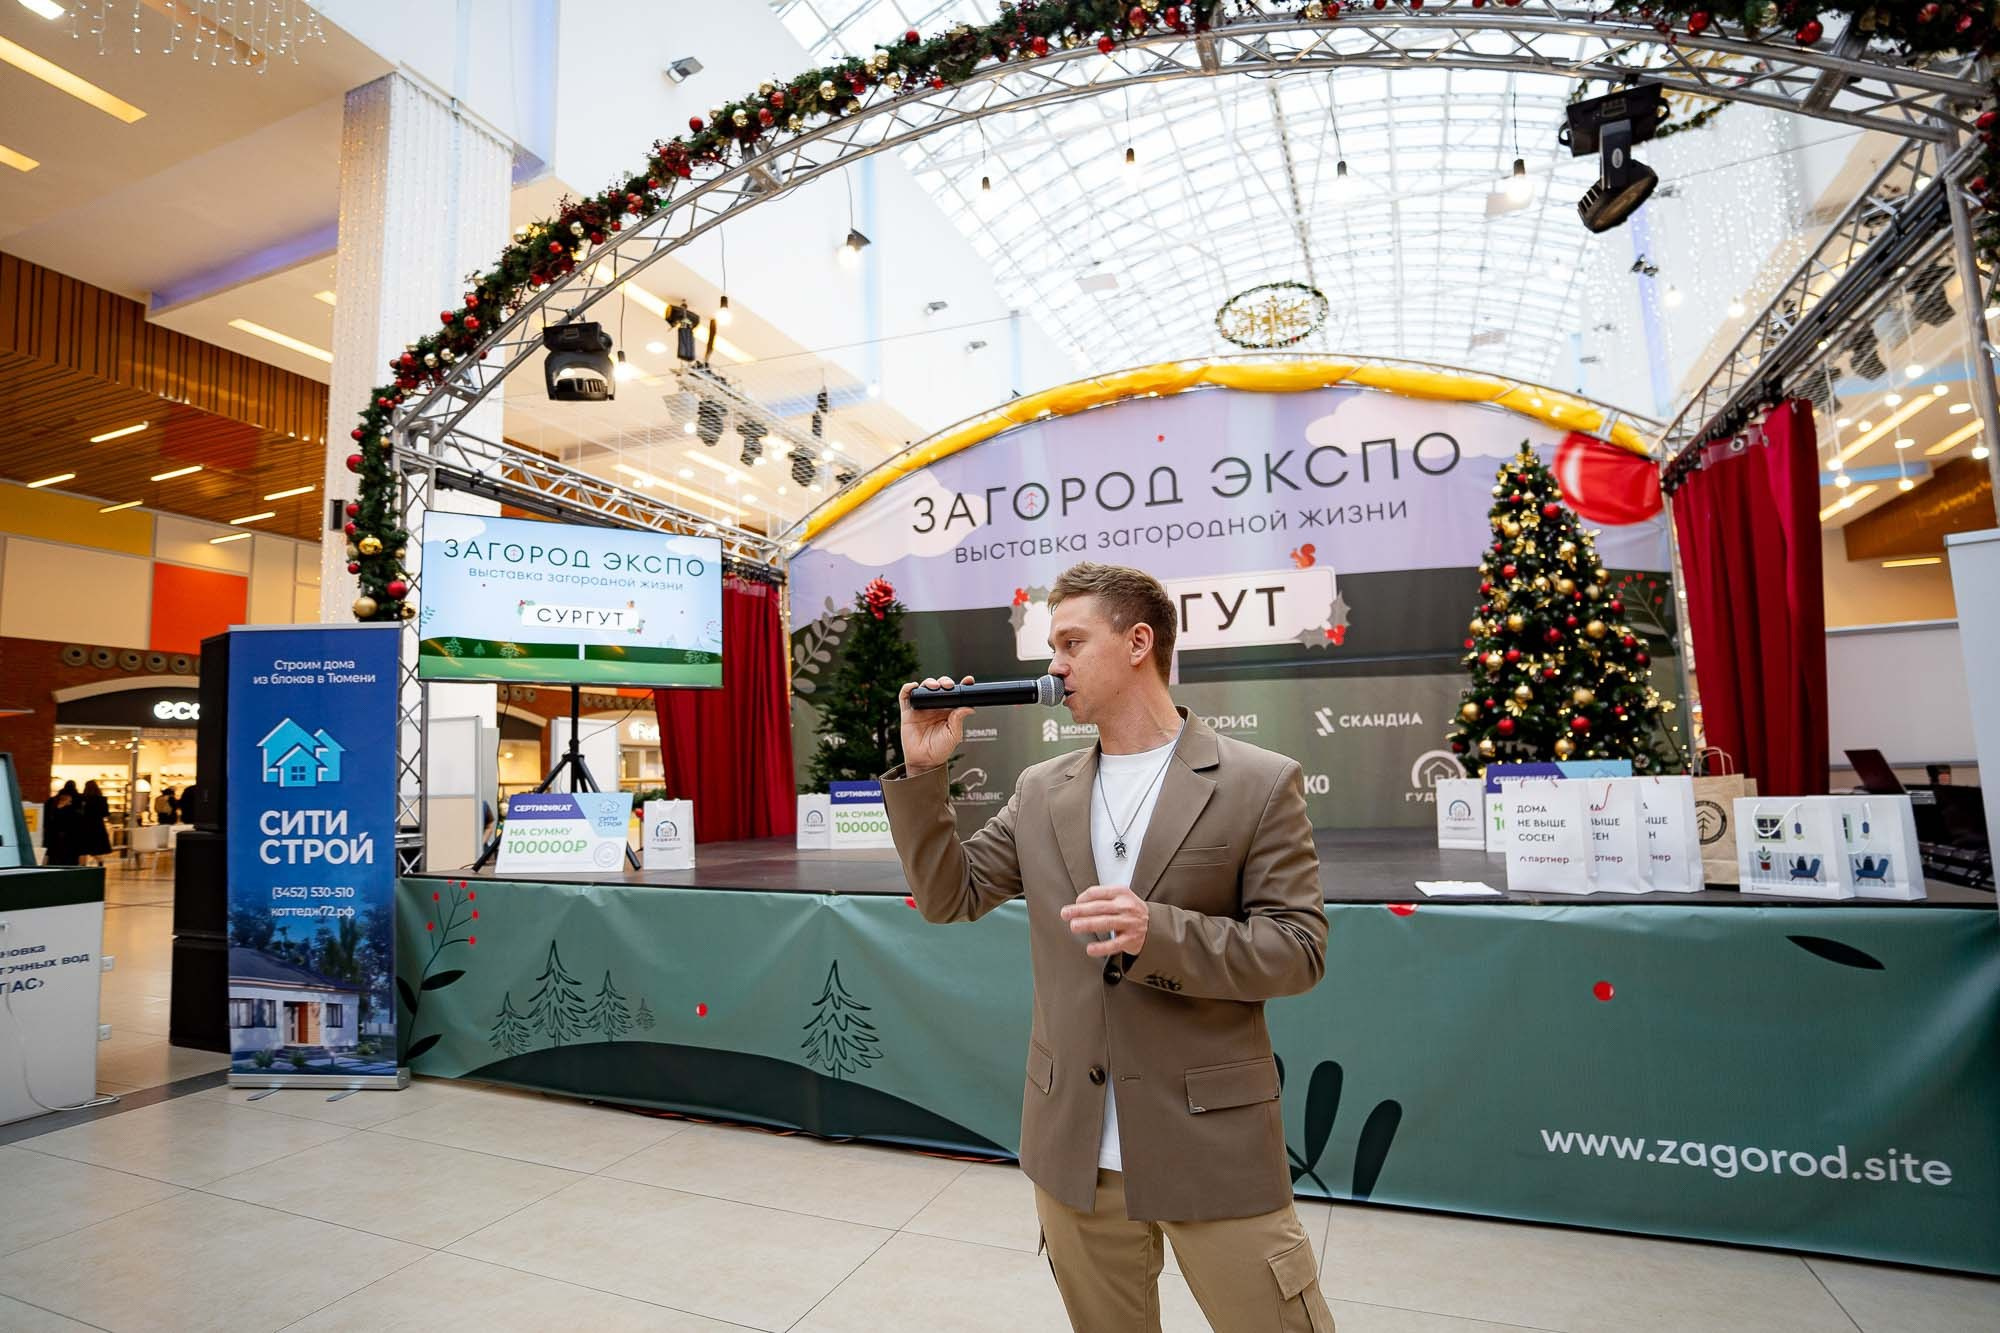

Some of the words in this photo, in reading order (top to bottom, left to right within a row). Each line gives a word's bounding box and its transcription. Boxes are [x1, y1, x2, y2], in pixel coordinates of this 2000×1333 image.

[912, 465, 1183, 534] ЗАГОРОД
[1210, 432, 1462, 498] ЭКСПО
[954, 532, 1087, 564] выставка
[1098, 509, 1288, 551] загородной
[1298, 500, 1407, 530] жизни
[443, 538, 591, 569] ЗАГОРОД
[603, 552, 705, 577] ЭКСПО
[468, 567, 543, 581] выставка
[547, 572, 636, 587] загородной
[640, 580, 684, 591] жизни
[1180, 586, 1285, 632] ГУТ
[536, 608, 624, 626] СУРГУТ
[273, 659, 321, 672] Строим
[323, 660, 356, 671] дома
[253, 676, 268, 685] из
[271, 673, 314, 684] блоков
[317, 675, 325, 683] в
[327, 672, 376, 683] Тюмени
[1339, 712, 1423, 729] СКАНДИА
[1060, 723, 1098, 736] МОНОЛ
[1304, 774, 1330, 794] КО
[1405, 791, 1435, 803] ГУД
[514, 803, 573, 813] СЕРТИФИКАТ
[1516, 804, 1547, 814] ДОМА
[260, 809, 348, 836] СИТИ
[1518, 819, 1531, 828] НЕ
[1533, 819, 1567, 828] ВЫШЕ
[509, 828, 526, 836] НА
[530, 827, 573, 837] СУММУ
[1518, 833, 1556, 842] СОСЕН
[260, 831, 374, 865] СТРОЙ
[1527, 855, 1570, 865] партнер
[272, 887, 308, 899] (3452)
[310, 886, 355, 898] 530-510
[271, 905, 355, 919] коттедж72.рф
[62, 953, 90, 965] вод
[1540, 1129, 1953, 1187] www.zagorod.site
